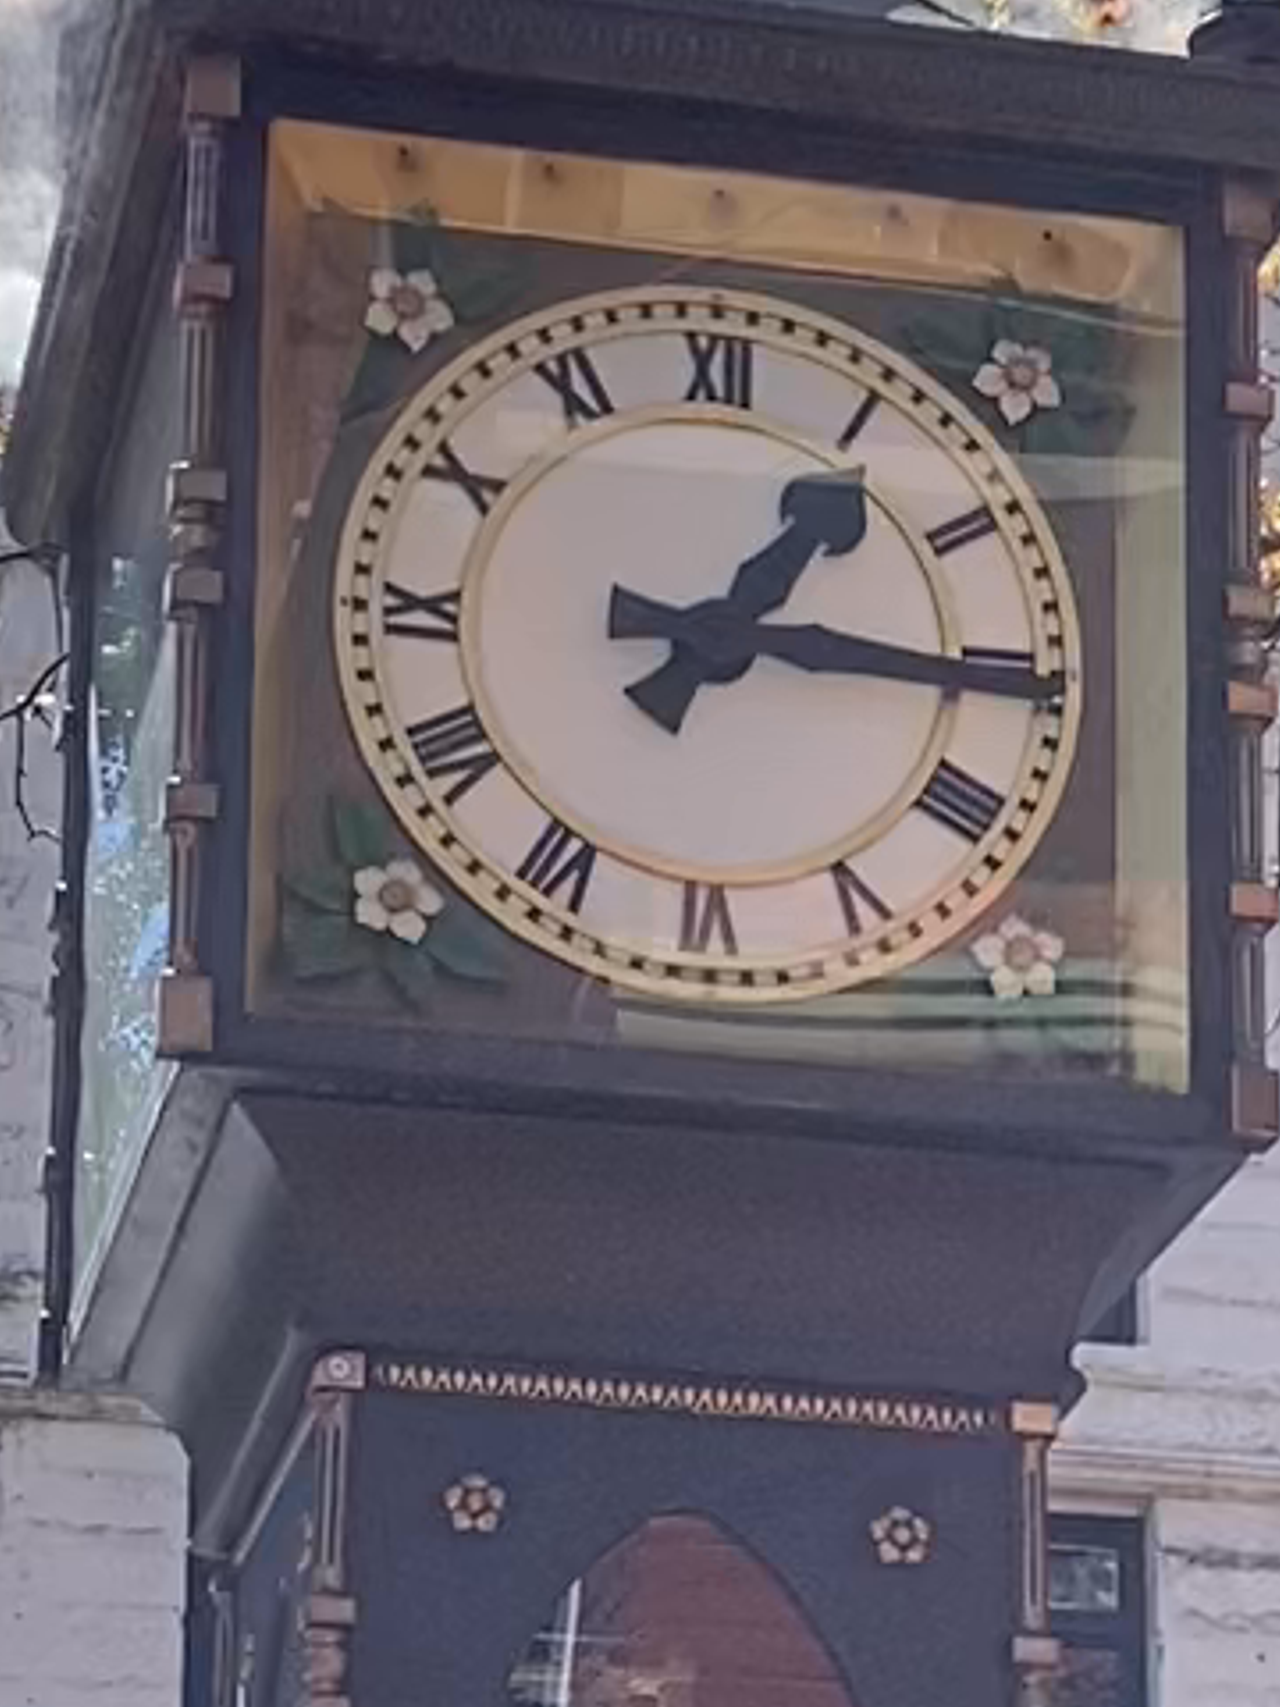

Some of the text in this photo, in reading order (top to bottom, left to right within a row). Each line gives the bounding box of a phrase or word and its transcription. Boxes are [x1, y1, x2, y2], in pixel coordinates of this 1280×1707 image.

[533, 346, 615, 429] XI
[685, 332, 752, 410] XII
[836, 392, 880, 451] I
[421, 439, 508, 518] X
[926, 506, 1000, 558] II
[382, 580, 461, 643] IX
[405, 704, 501, 807] VIII
[515, 816, 597, 915] VII
[830, 860, 894, 935] V
[677, 879, 739, 956] VI
